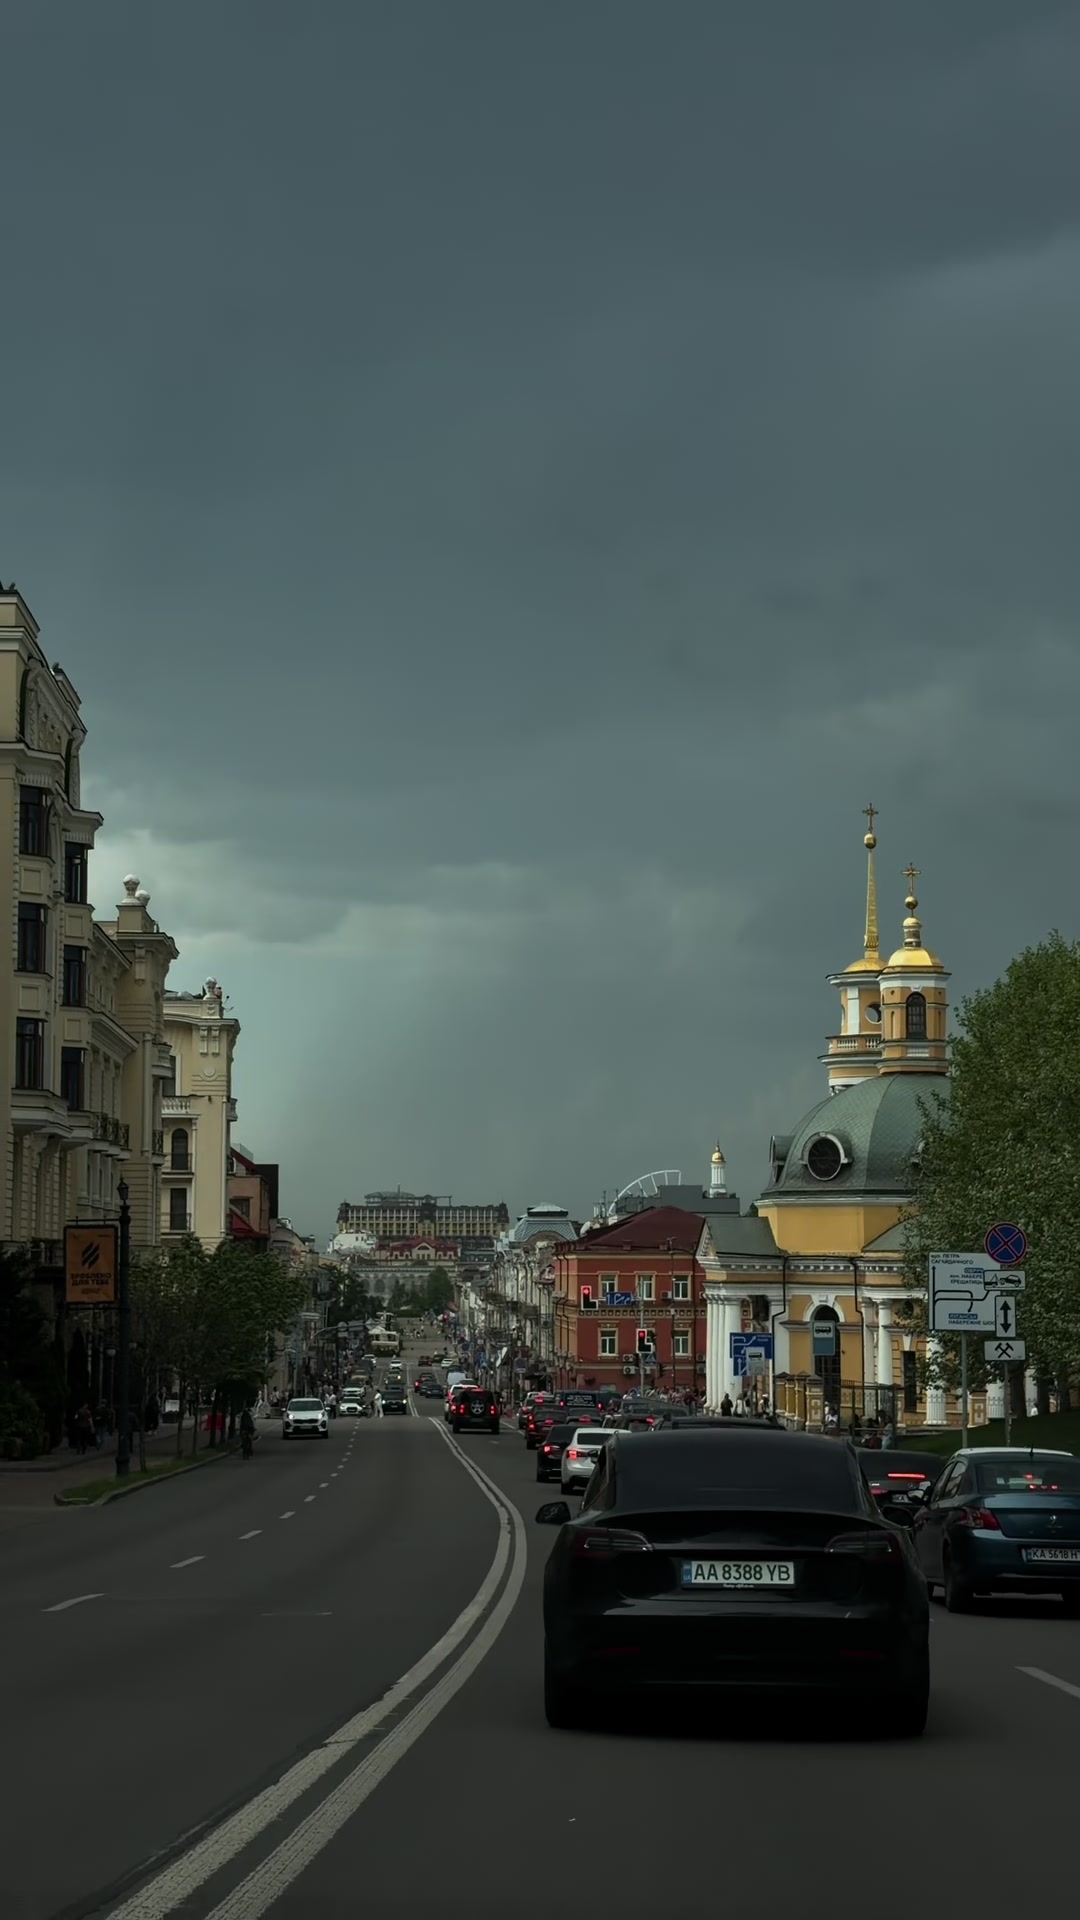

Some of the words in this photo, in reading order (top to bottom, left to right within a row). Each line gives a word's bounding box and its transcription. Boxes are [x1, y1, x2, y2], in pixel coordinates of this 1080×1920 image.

[1032, 1549, 1046, 1559] KA
[694, 1563, 718, 1581] AA
[722, 1564, 762, 1581] 8388
[766, 1564, 791, 1581] YB
